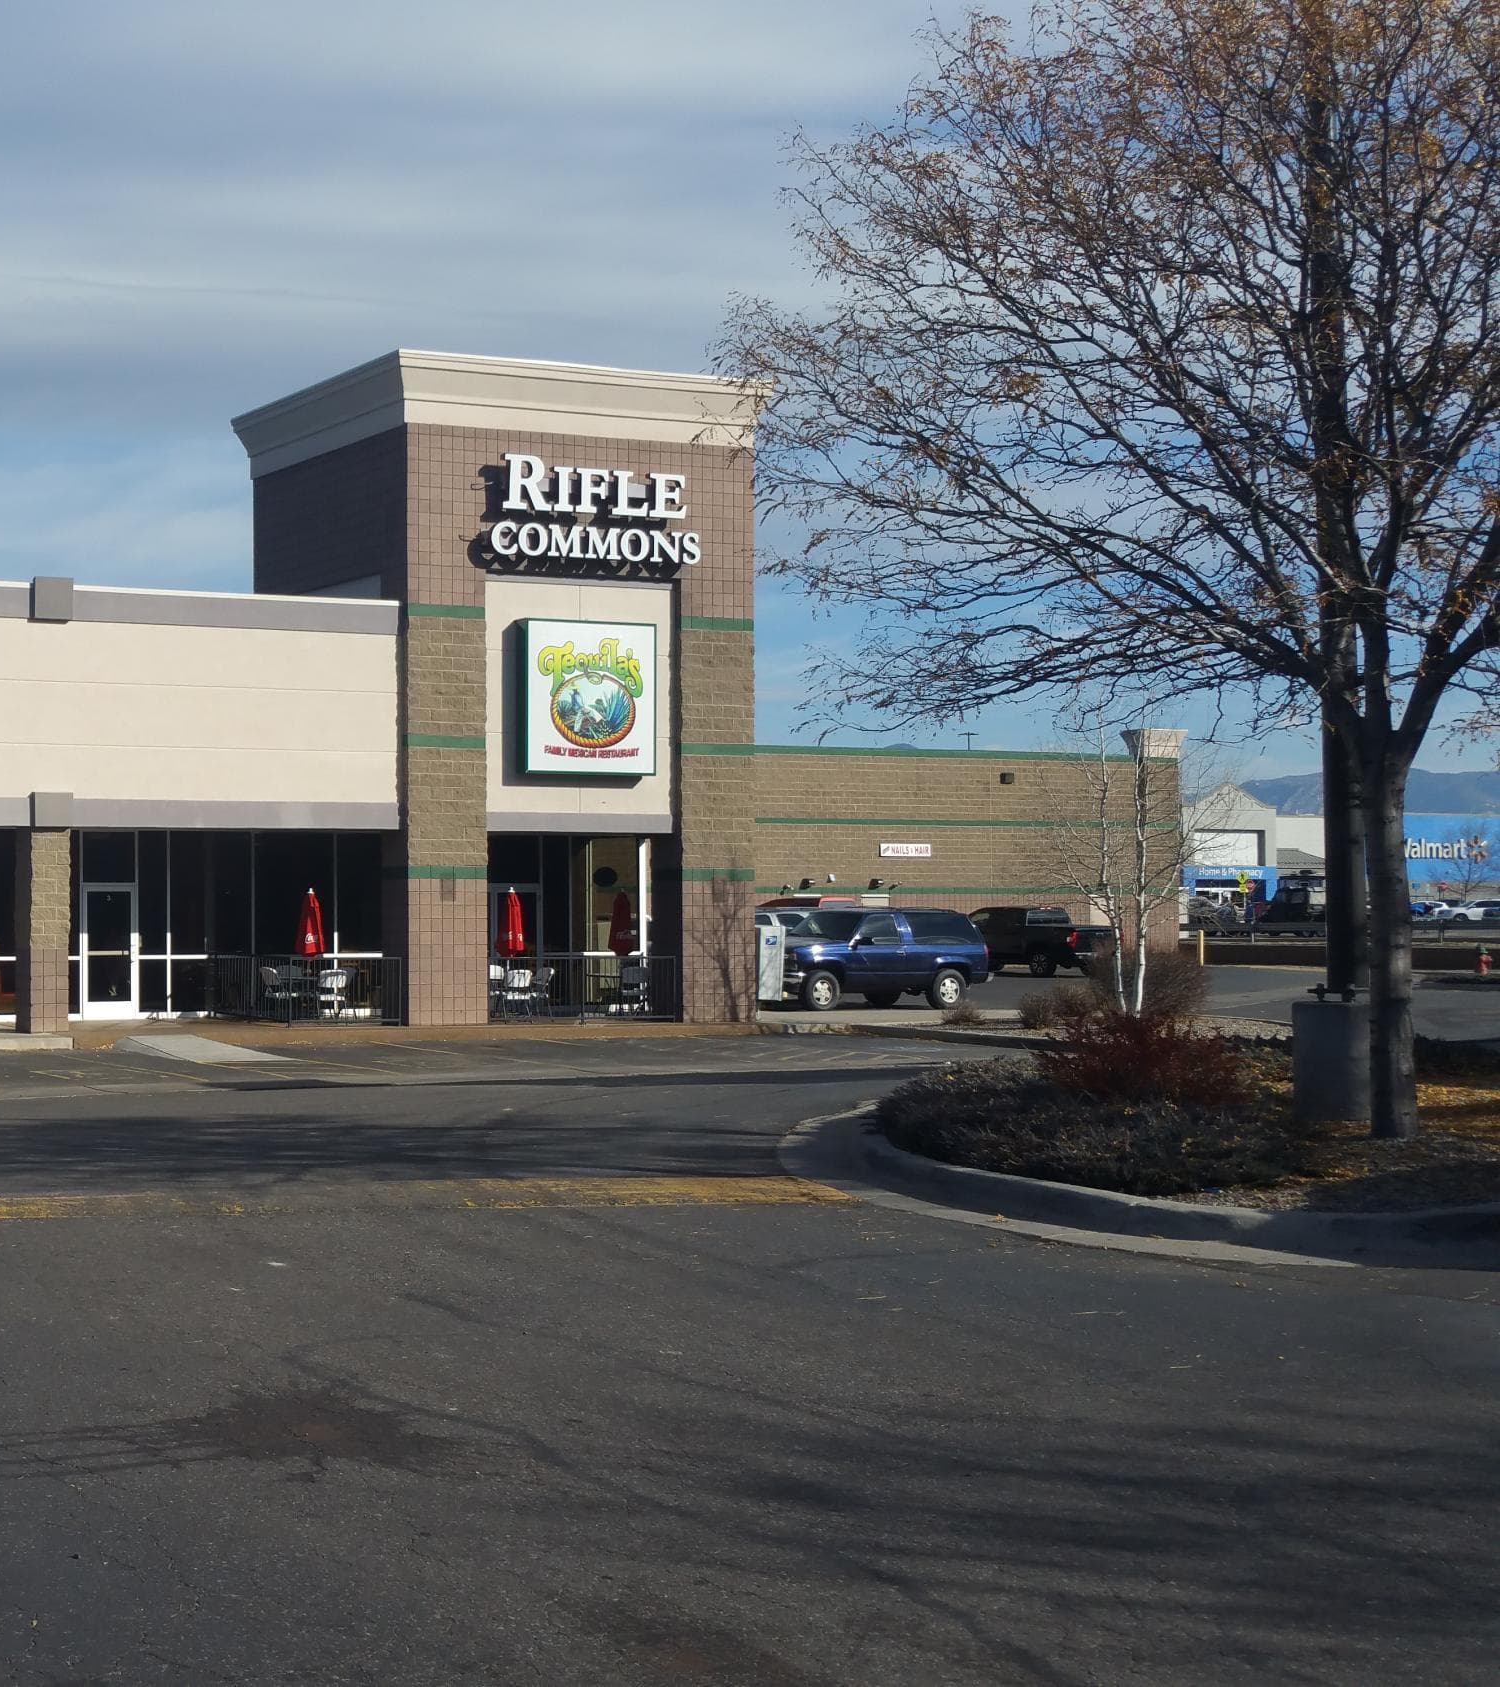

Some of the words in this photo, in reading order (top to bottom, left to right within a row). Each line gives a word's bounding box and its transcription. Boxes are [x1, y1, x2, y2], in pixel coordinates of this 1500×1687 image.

[502, 453, 687, 519] RIFLE
[491, 521, 701, 565] COMMONS
[538, 638, 643, 698] Tequila's
[544, 745, 567, 756] FAMILY
[891, 845, 909, 855] NAILS
[914, 846, 930, 855] HAIR
[1199, 867, 1220, 876] Home
